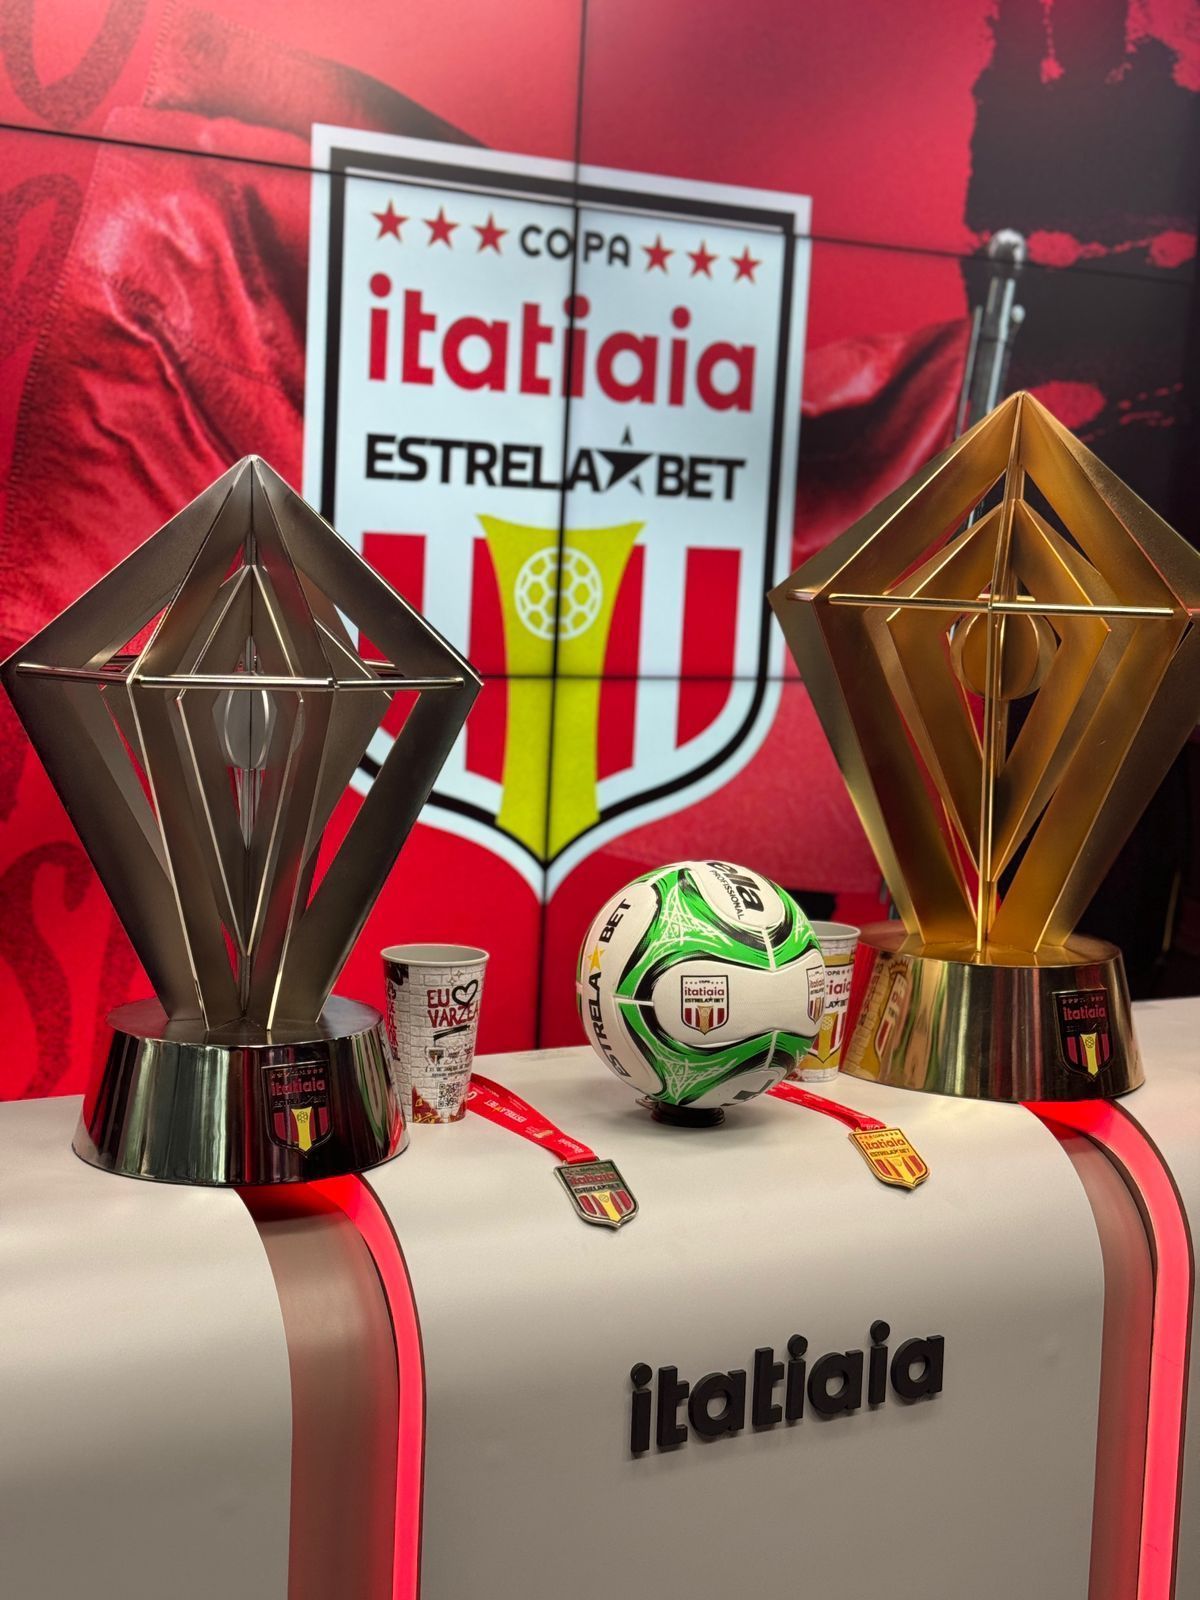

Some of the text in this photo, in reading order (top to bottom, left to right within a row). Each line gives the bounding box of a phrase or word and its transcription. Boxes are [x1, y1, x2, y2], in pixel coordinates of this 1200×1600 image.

[520, 223, 631, 267] COPA
[368, 272, 756, 413] itatiaia
[365, 432, 746, 501] ESTRELA BET
[709, 869, 745, 920] PROFISSIONAL
[427, 988, 450, 1008] EU
[588, 898, 631, 1078] ESTRELA BET
[684, 986, 725, 996] itatiaia
[862, 1137, 907, 1150] itatiaia
[630, 1319, 945, 1454] itatiaia
